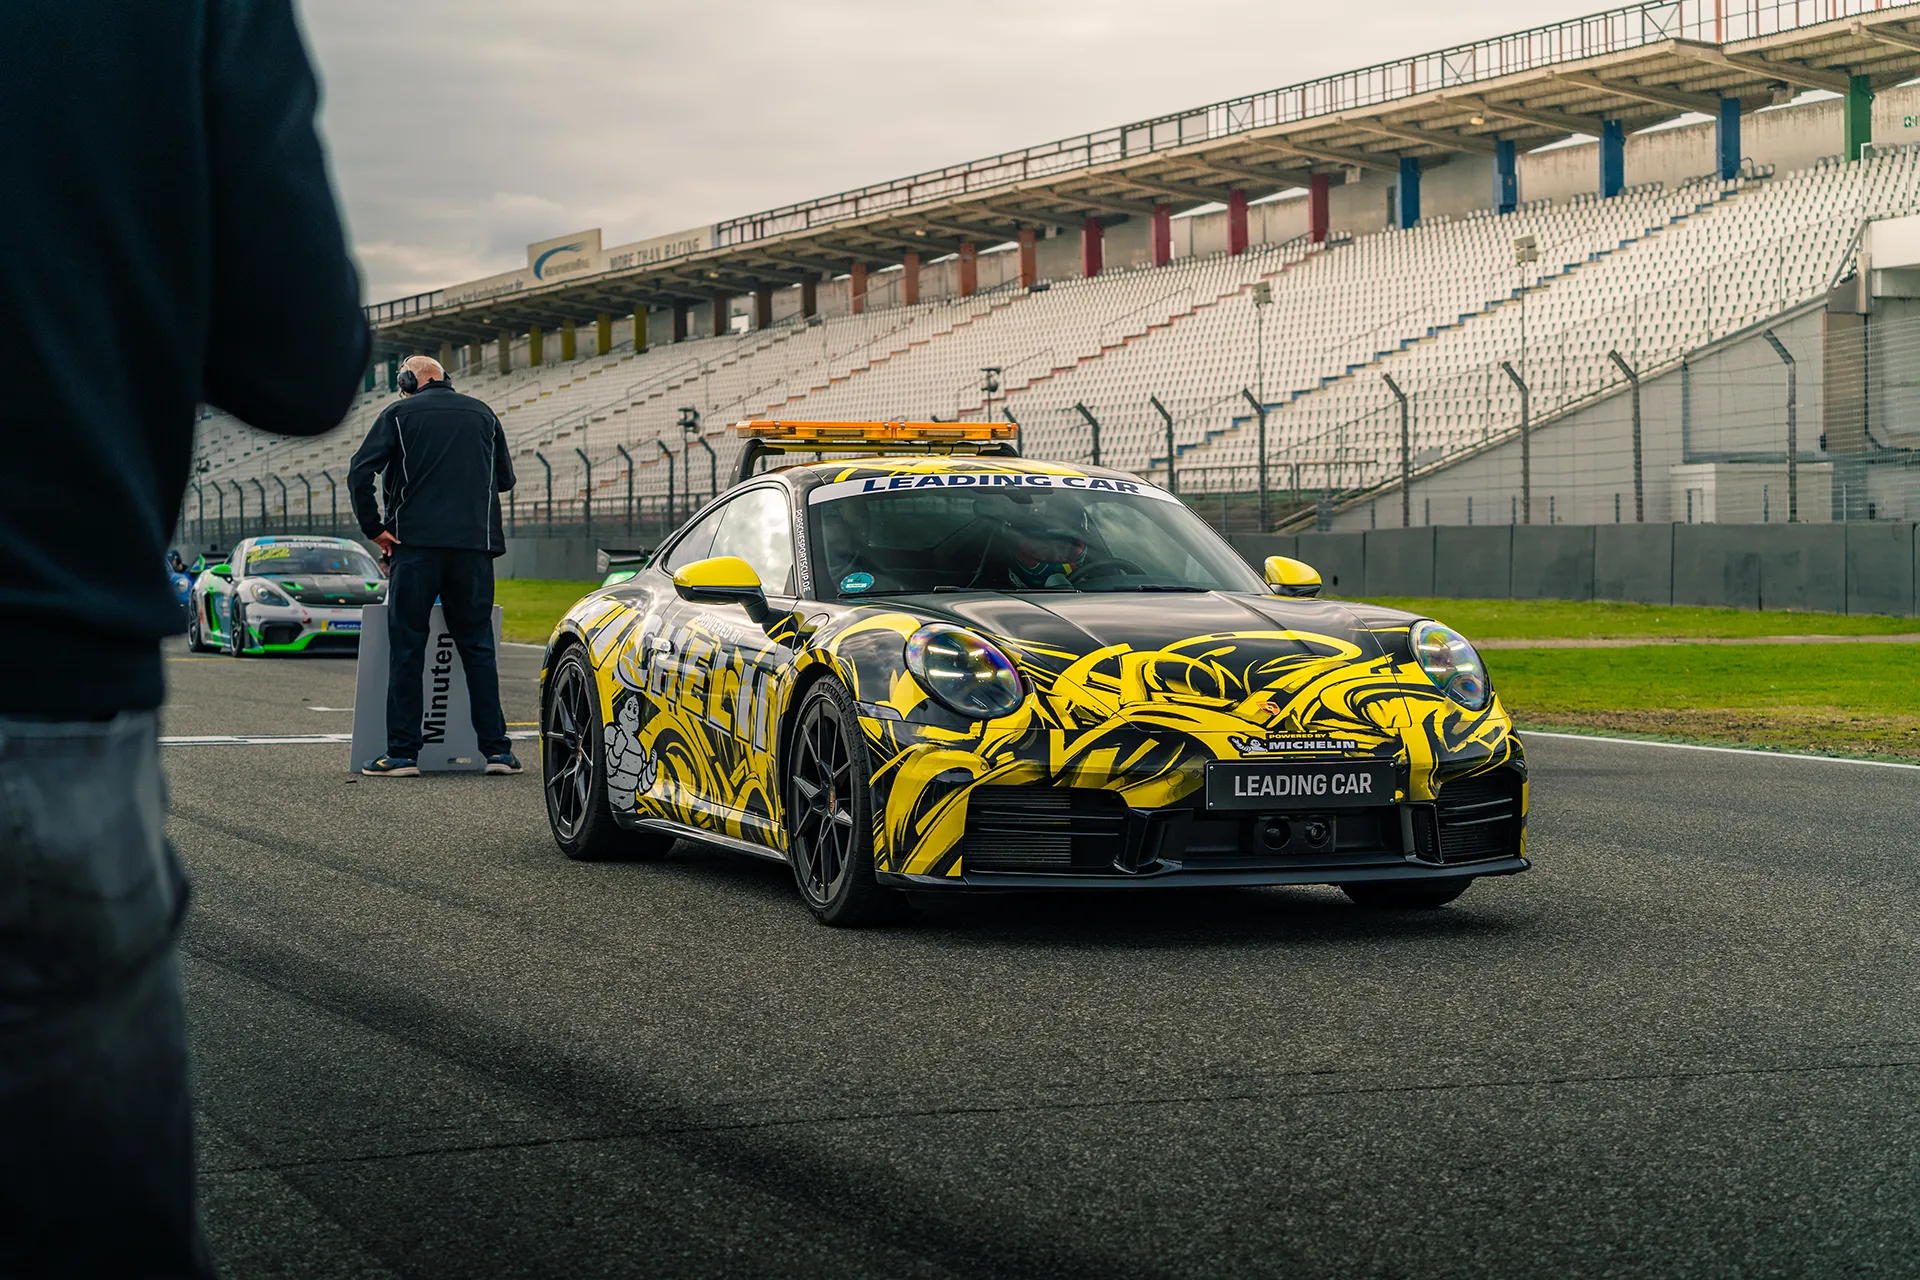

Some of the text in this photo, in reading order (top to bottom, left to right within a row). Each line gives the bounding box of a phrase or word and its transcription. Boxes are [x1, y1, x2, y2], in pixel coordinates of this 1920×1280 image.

[861, 475, 1141, 495] LEADING CAR
[795, 508, 812, 594] PORSCHESPORTSCUP.DE
[695, 611, 747, 646] POWERED BY
[423, 632, 454, 744] Minuten
[1268, 741, 1357, 750] MICHELIN
[1234, 773, 1373, 797] LEADING CAR
